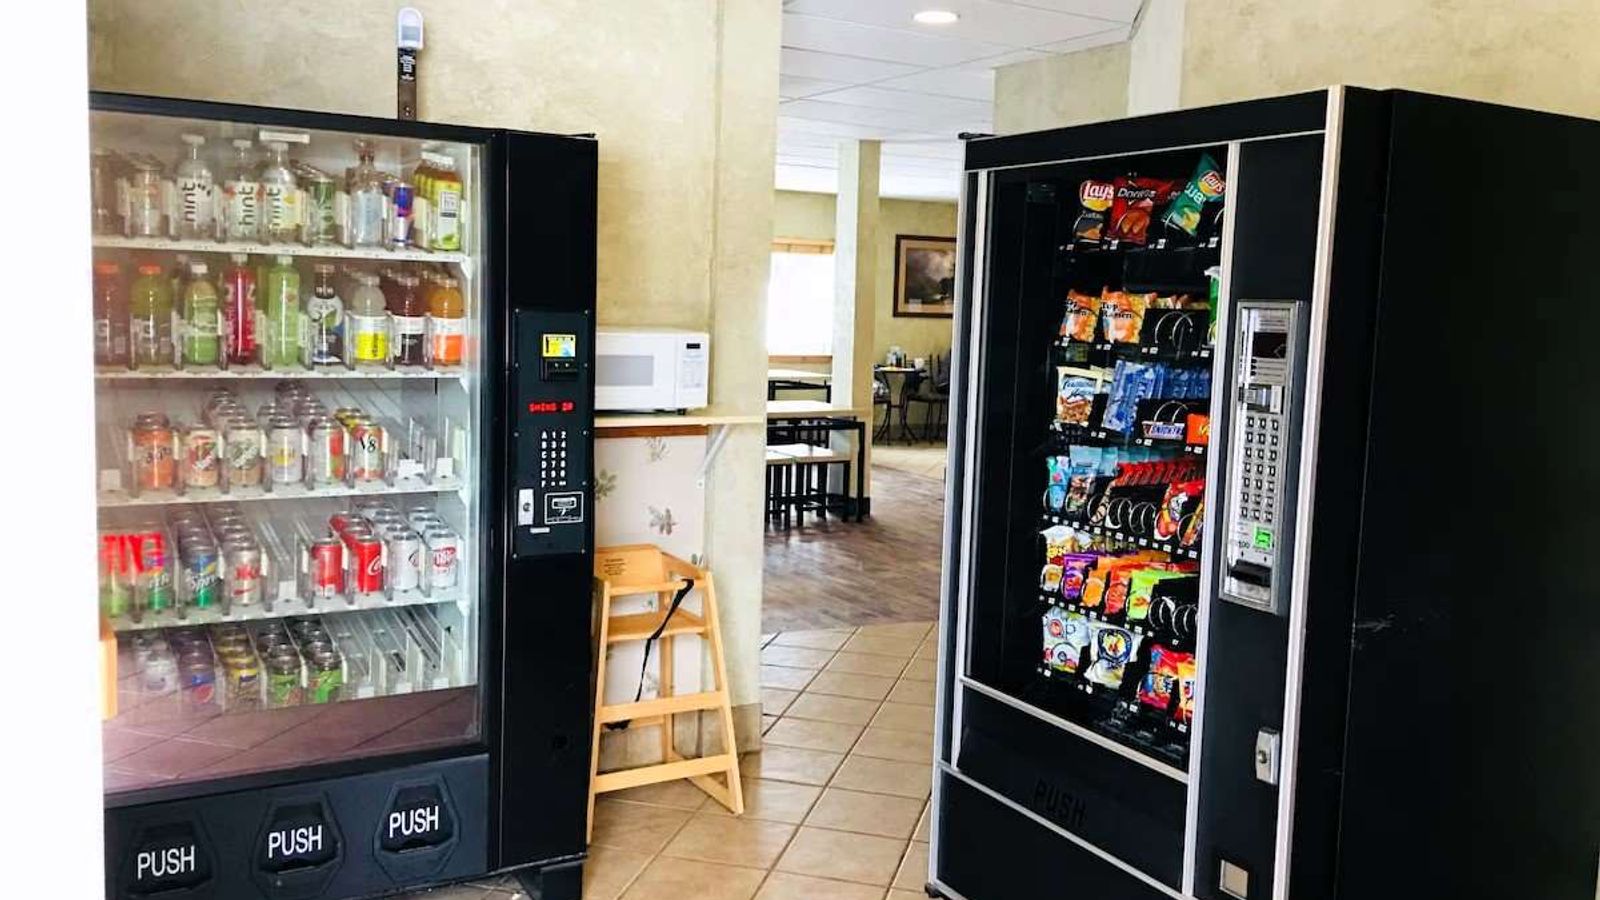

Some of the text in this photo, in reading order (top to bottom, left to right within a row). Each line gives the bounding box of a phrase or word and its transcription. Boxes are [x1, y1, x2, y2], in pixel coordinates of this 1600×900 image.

[238, 184, 255, 226] hint
[1117, 186, 1157, 199] Doritos
[388, 806, 440, 838] PUSH
[267, 826, 323, 858] PUSH
[136, 846, 196, 880] PUSH
